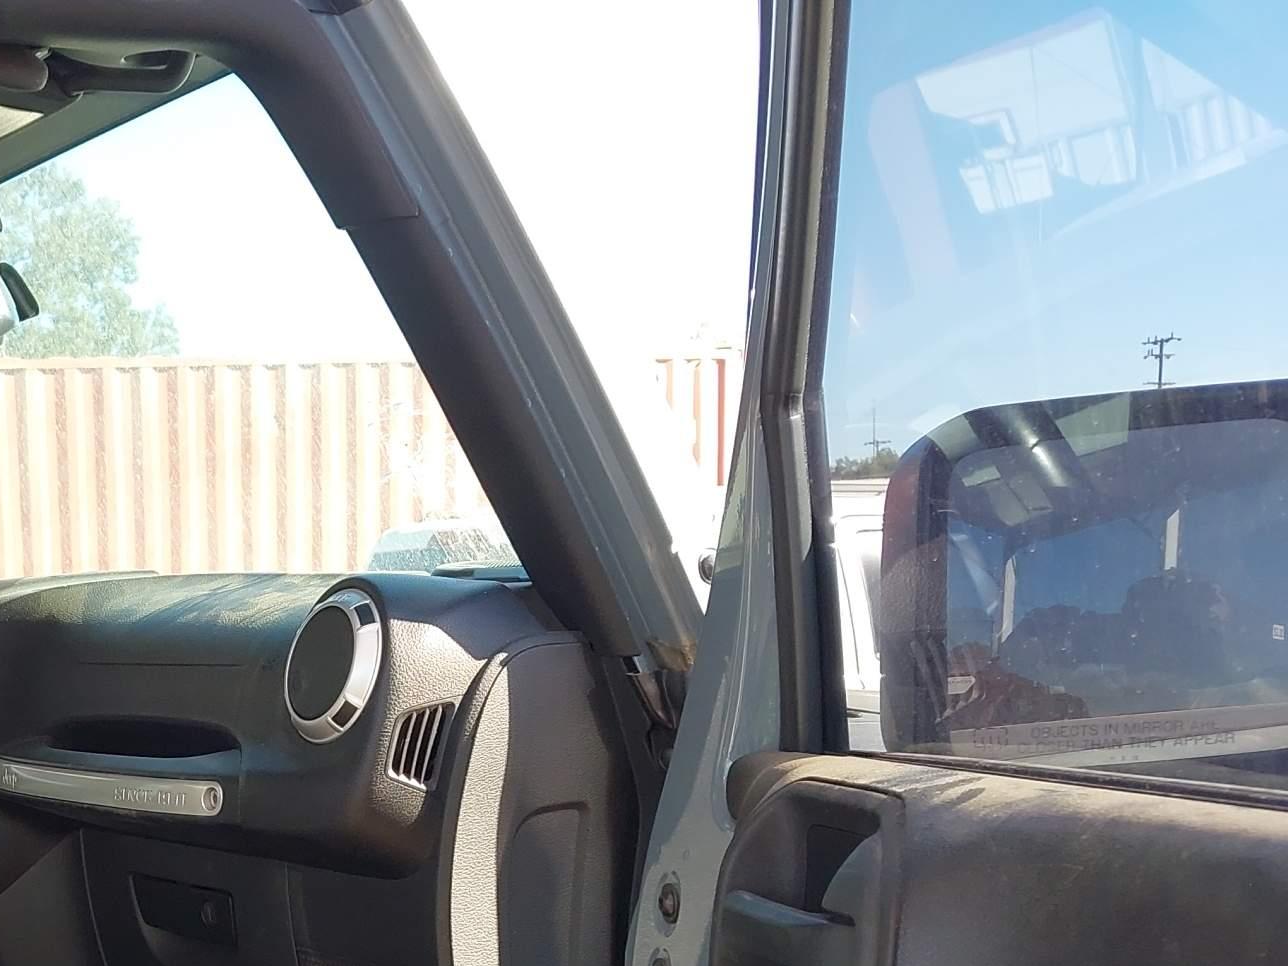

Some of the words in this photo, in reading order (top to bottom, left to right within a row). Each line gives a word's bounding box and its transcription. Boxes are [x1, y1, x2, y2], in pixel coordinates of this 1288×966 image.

[1030, 723, 1099, 738] OBJECTS
[1104, 722, 1119, 735] IN
[1123, 719, 1184, 735] MIRROR
[1174, 732, 1236, 747] APPEAR
